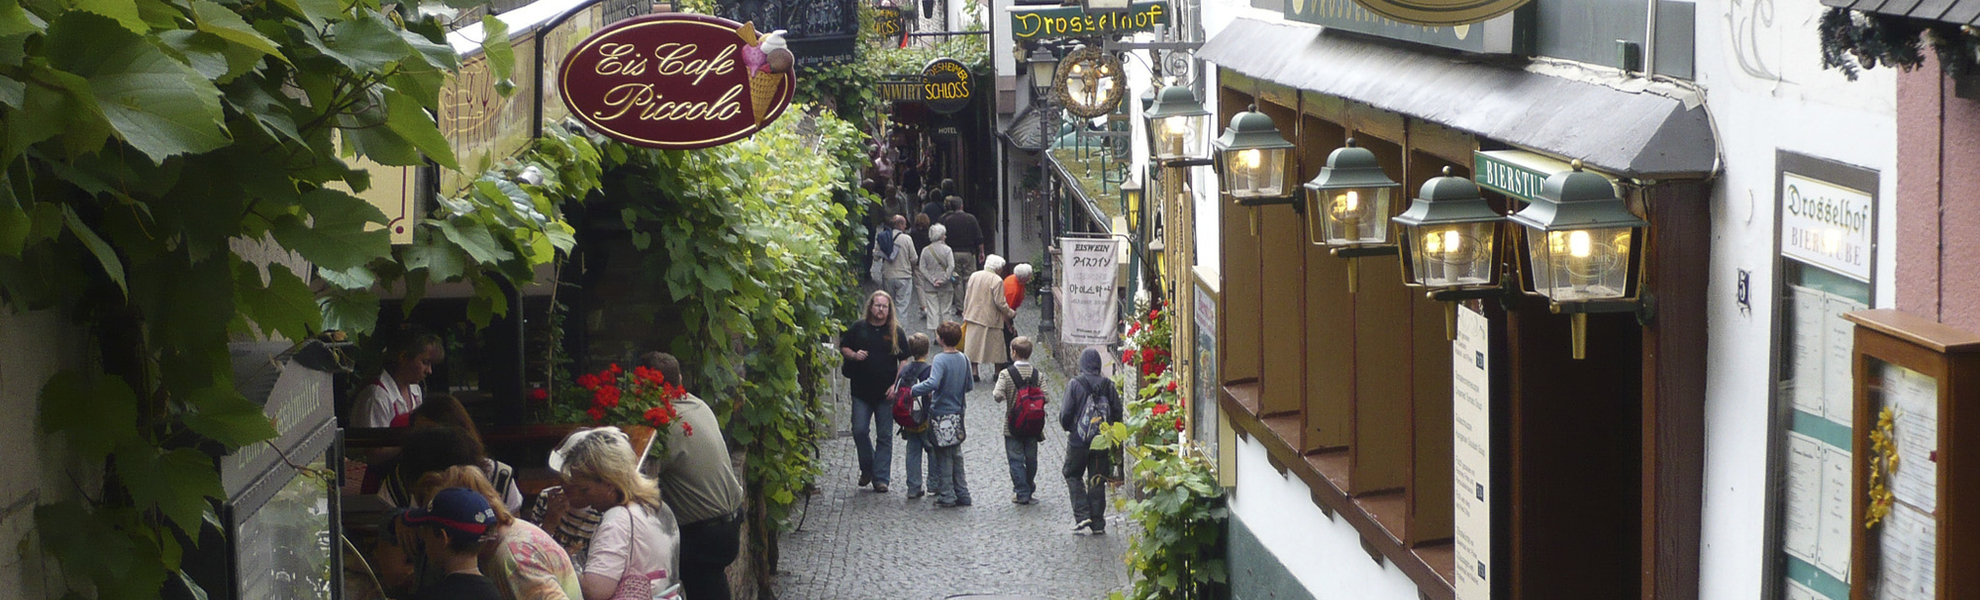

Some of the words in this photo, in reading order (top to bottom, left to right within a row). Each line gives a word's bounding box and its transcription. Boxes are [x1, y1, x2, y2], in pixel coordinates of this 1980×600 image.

[595, 43, 648, 76] Eis
[654, 42, 738, 86] Cafe
[593, 83, 744, 121] Piccolo
[925, 81, 969, 100] SCHLOSS
[1788, 184, 1868, 242] Drosselhof
[1074, 244, 1110, 252] EISWEIN
[1739, 270, 1747, 301] 5
